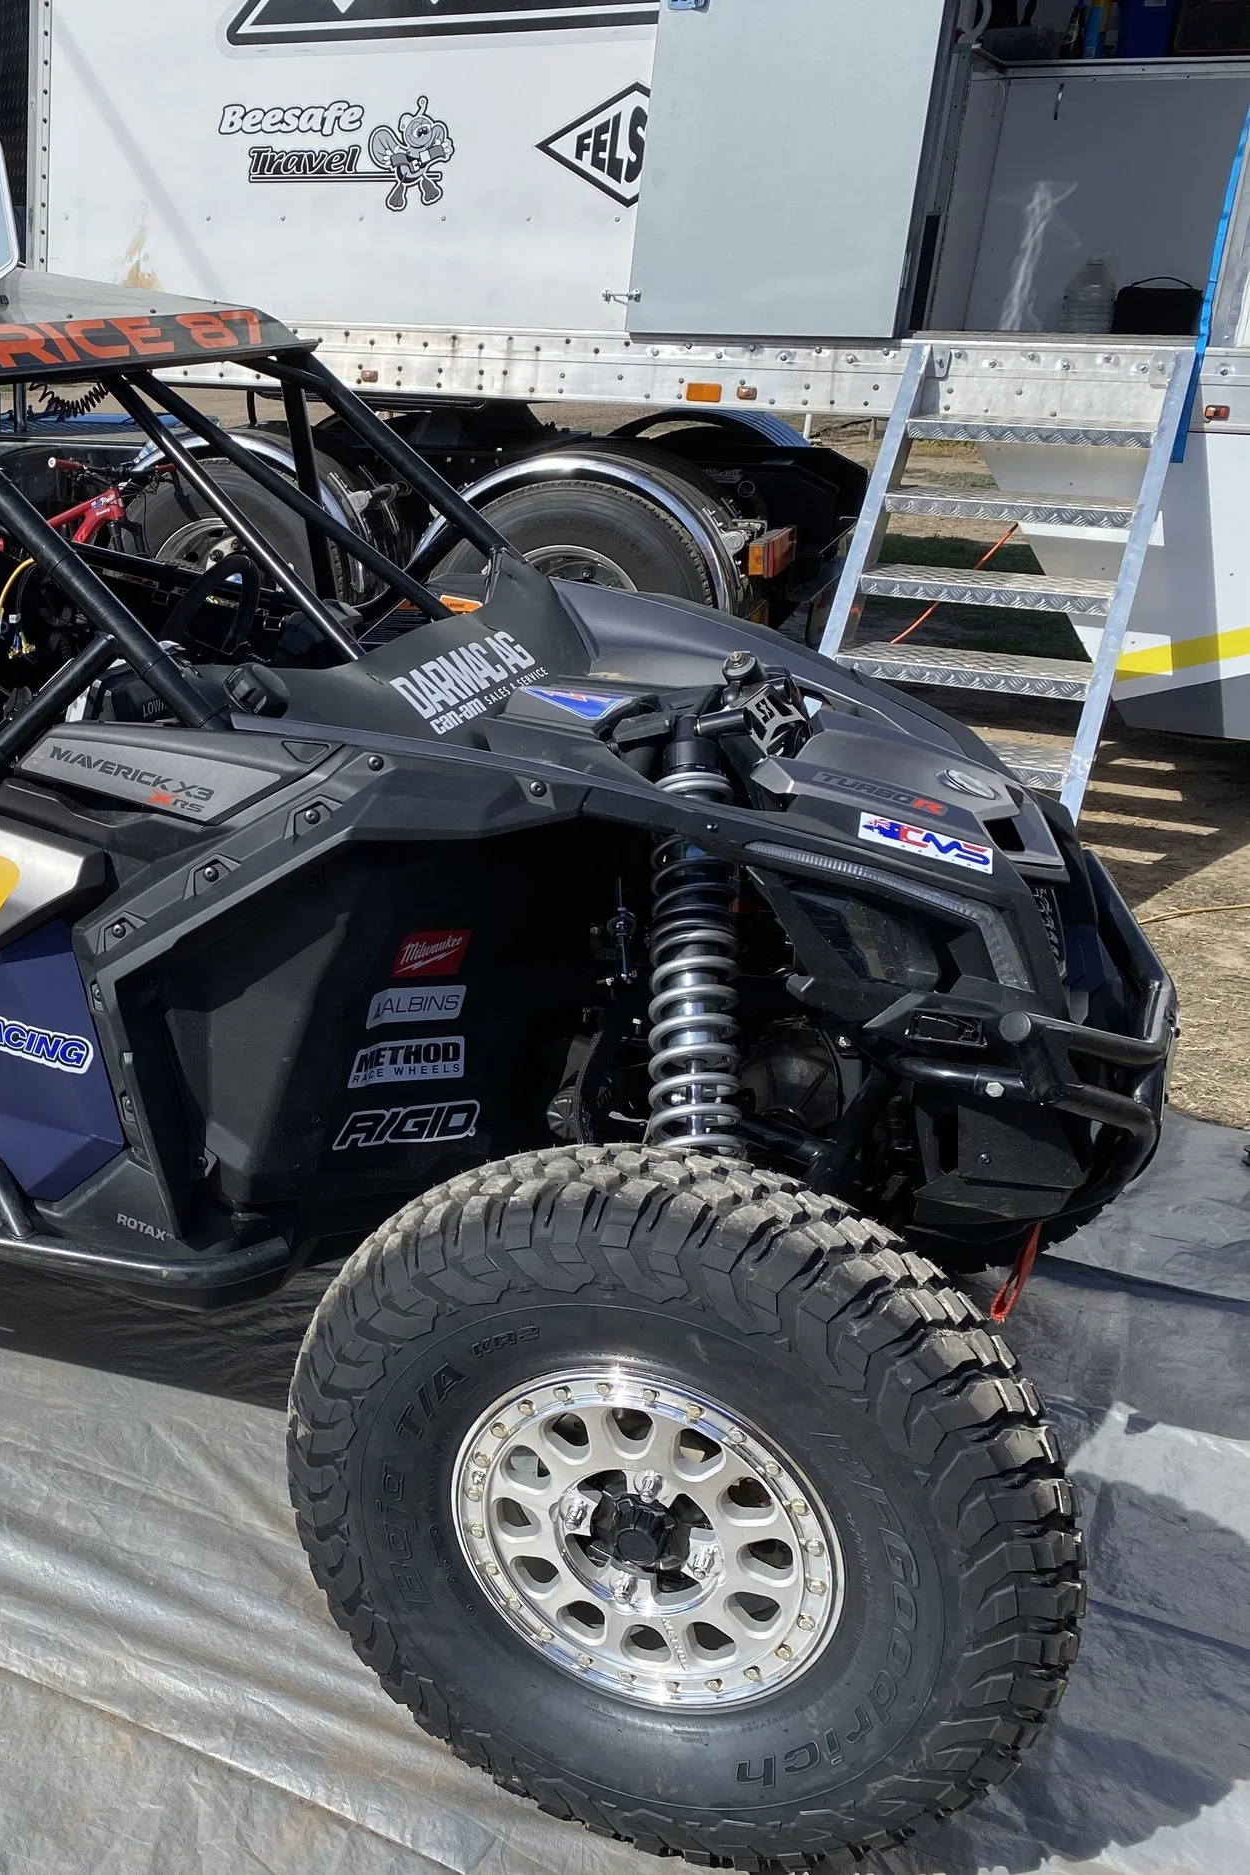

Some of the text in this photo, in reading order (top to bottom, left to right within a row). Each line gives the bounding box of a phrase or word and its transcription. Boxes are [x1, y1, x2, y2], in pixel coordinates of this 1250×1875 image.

[218, 101, 365, 137] Beesafe
[248, 144, 362, 175] Travel
[176, 309, 263, 349] 87
[389, 631, 536, 720] DARMAC AG
[484, 686, 511, 705] SALES
[516, 666, 549, 687] SERVICE
[429, 695, 487, 736] can-am
[49, 746, 215, 801] MAVERICK X3
[400, 934, 463, 966] Milwaukee
[381, 994, 460, 1014] ALBINS
[352, 1063, 461, 1084] RACE WHEELS
[355, 1042, 461, 1074] METHOD
[334, 1101, 479, 1149] RIGID
[116, 1212, 167, 1242] ROTAX
[470, 1324, 541, 1359] KR2
